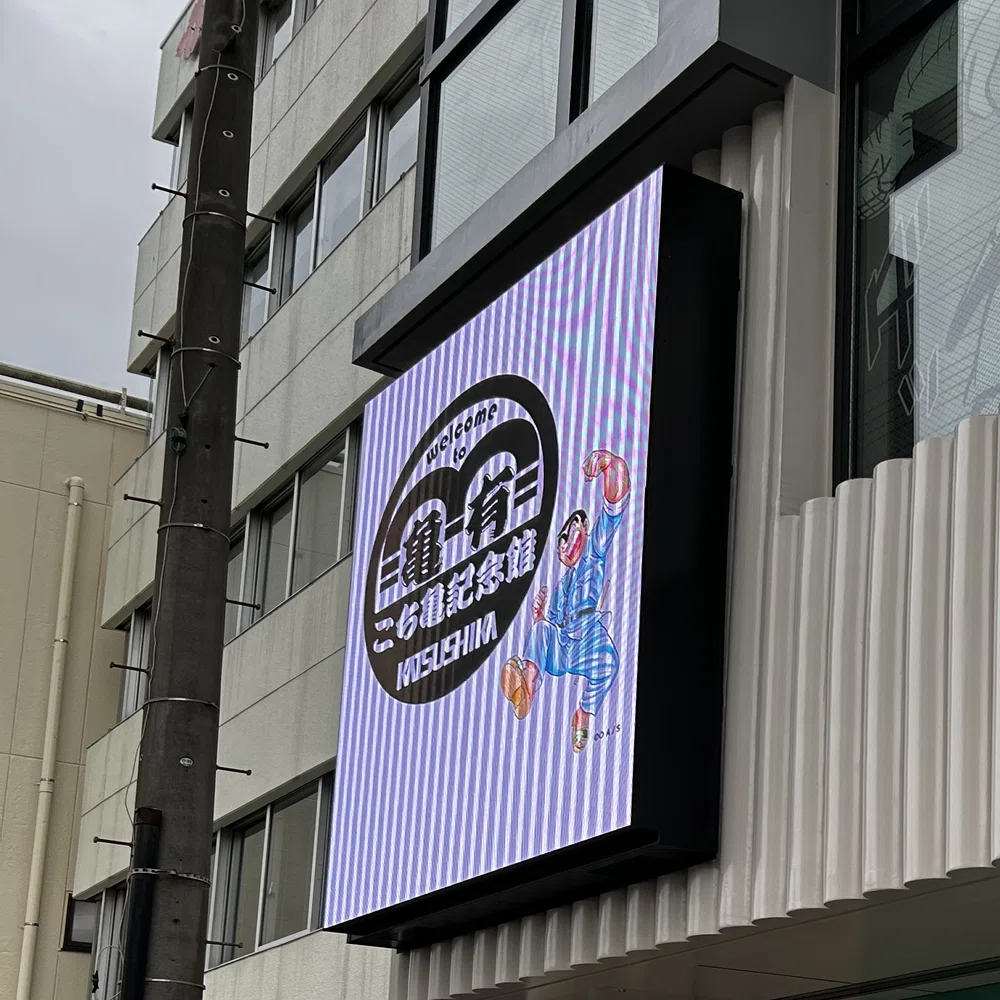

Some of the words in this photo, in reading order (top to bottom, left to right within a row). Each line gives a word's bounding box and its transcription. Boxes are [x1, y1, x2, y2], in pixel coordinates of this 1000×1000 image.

[425, 402, 498, 465] welcome
[452, 448, 468, 464] to
[374, 528, 539, 654] こち亀記念館
[396, 611, 498, 691] KATSUSHIKA
